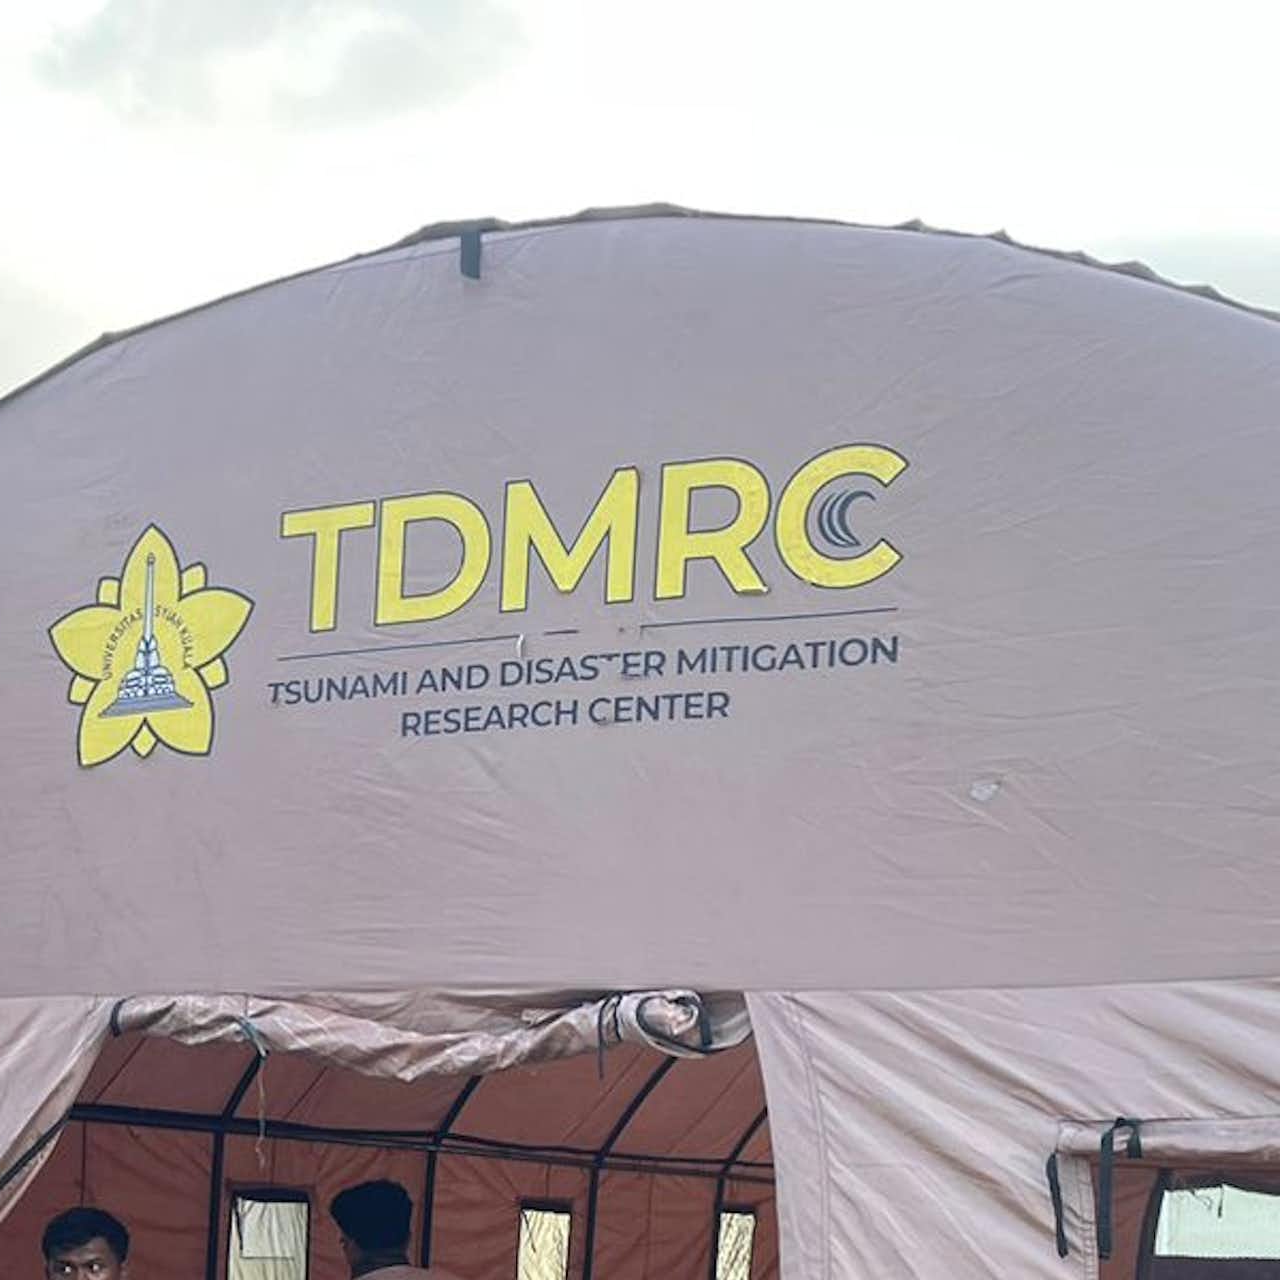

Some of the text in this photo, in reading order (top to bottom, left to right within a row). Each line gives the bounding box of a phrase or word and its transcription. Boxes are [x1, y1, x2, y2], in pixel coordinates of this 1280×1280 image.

[280, 443, 909, 634] TDMRC
[103, 608, 144, 681] UNIVERSITAS
[268, 635, 899, 705] TSUNAMI AND DISASTER MITIGATION
[401, 691, 731, 737] RESEARCH CENTER
